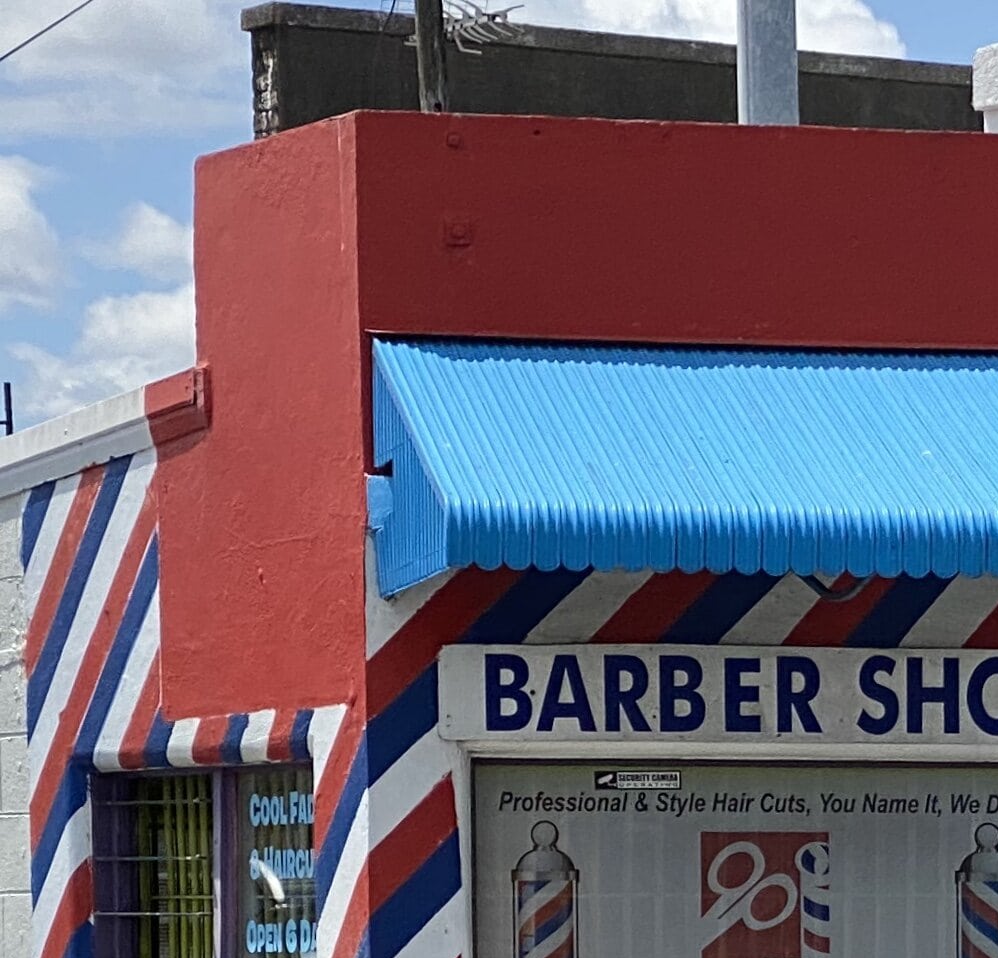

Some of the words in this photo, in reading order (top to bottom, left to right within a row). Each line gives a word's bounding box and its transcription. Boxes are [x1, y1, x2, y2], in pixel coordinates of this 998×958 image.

[484, 653, 823, 733] BARBER
[499, 791, 629, 813] Professional
[634, 792, 649, 813] &
[656, 792, 706, 818] Style
[712, 793, 755, 813] Hair
[760, 793, 811, 817] Cuts,
[820, 793, 855, 814] You
[862, 793, 919, 814] Name
[925, 793, 942, 818] It,
[951, 794, 980, 814] We
